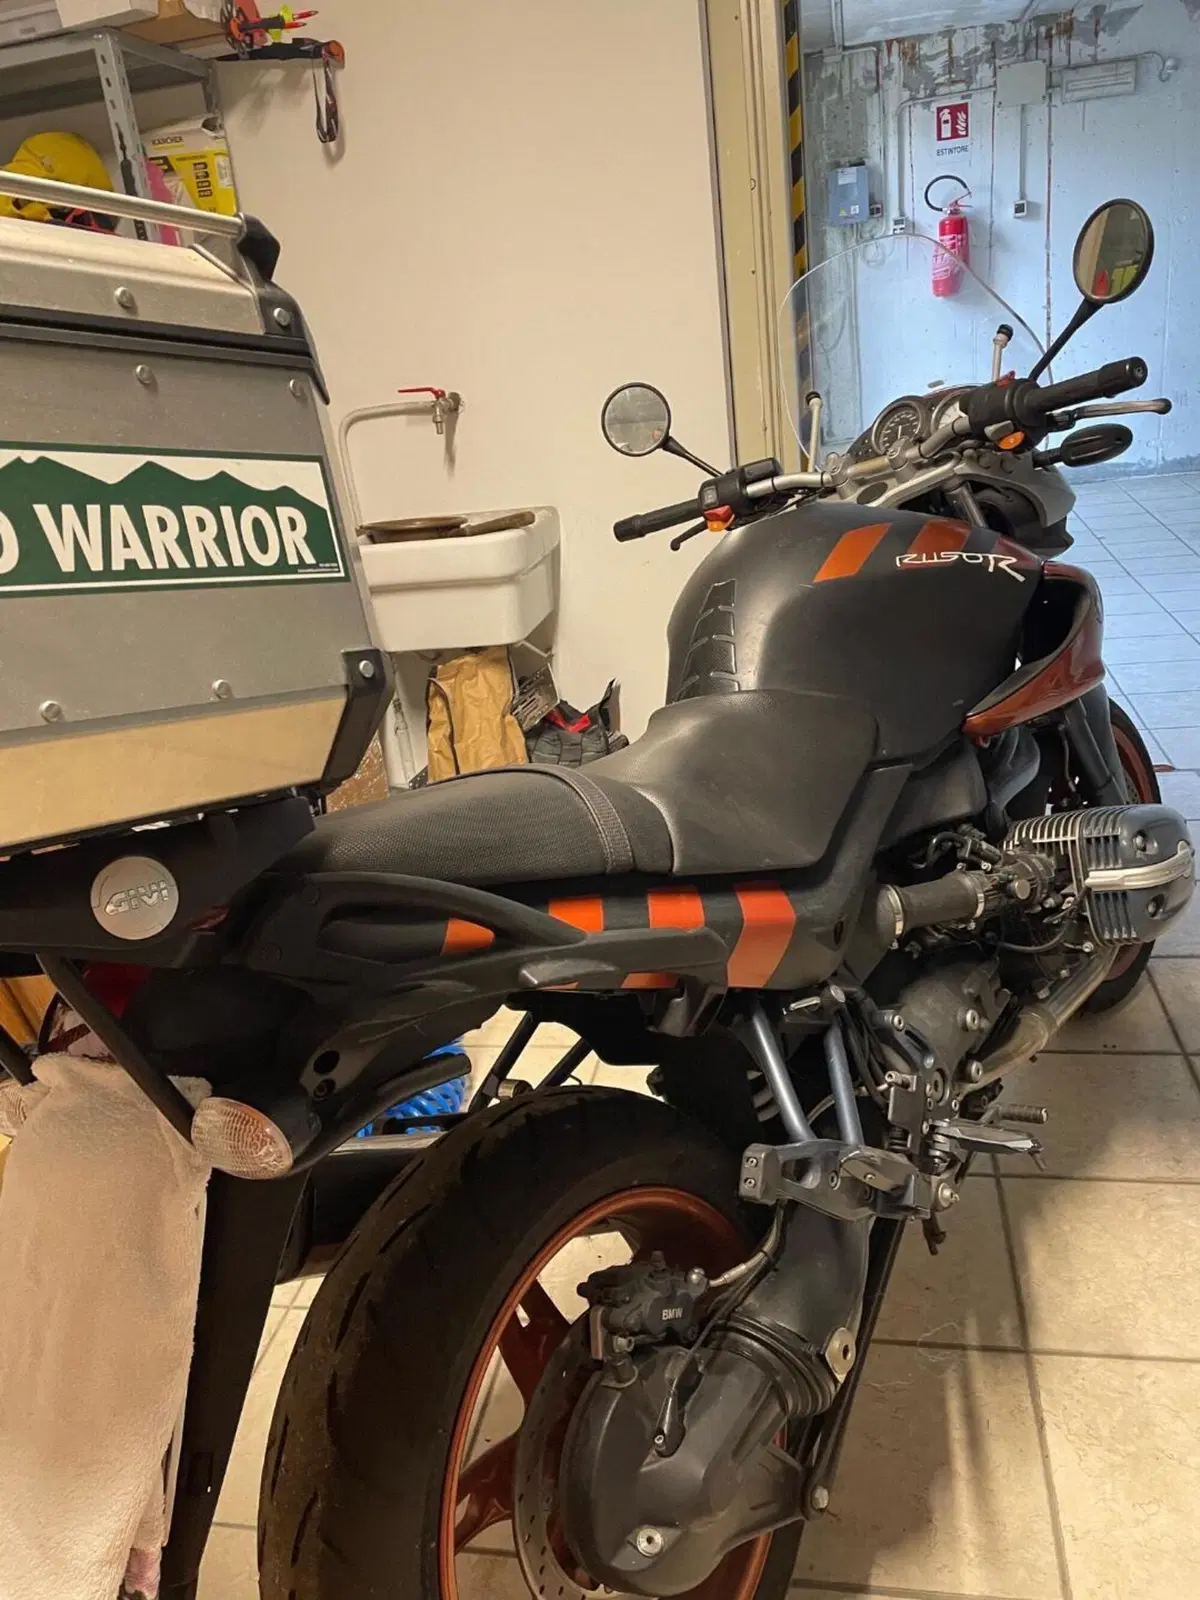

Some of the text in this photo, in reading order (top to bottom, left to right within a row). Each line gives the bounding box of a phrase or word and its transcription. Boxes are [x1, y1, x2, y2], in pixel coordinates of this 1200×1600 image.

[936, 144, 969, 157] ESTINTORE
[32, 503, 316, 573] WARRIOR
[104, 880, 169, 916] GIVI
[661, 1307, 683, 1321] BMW
